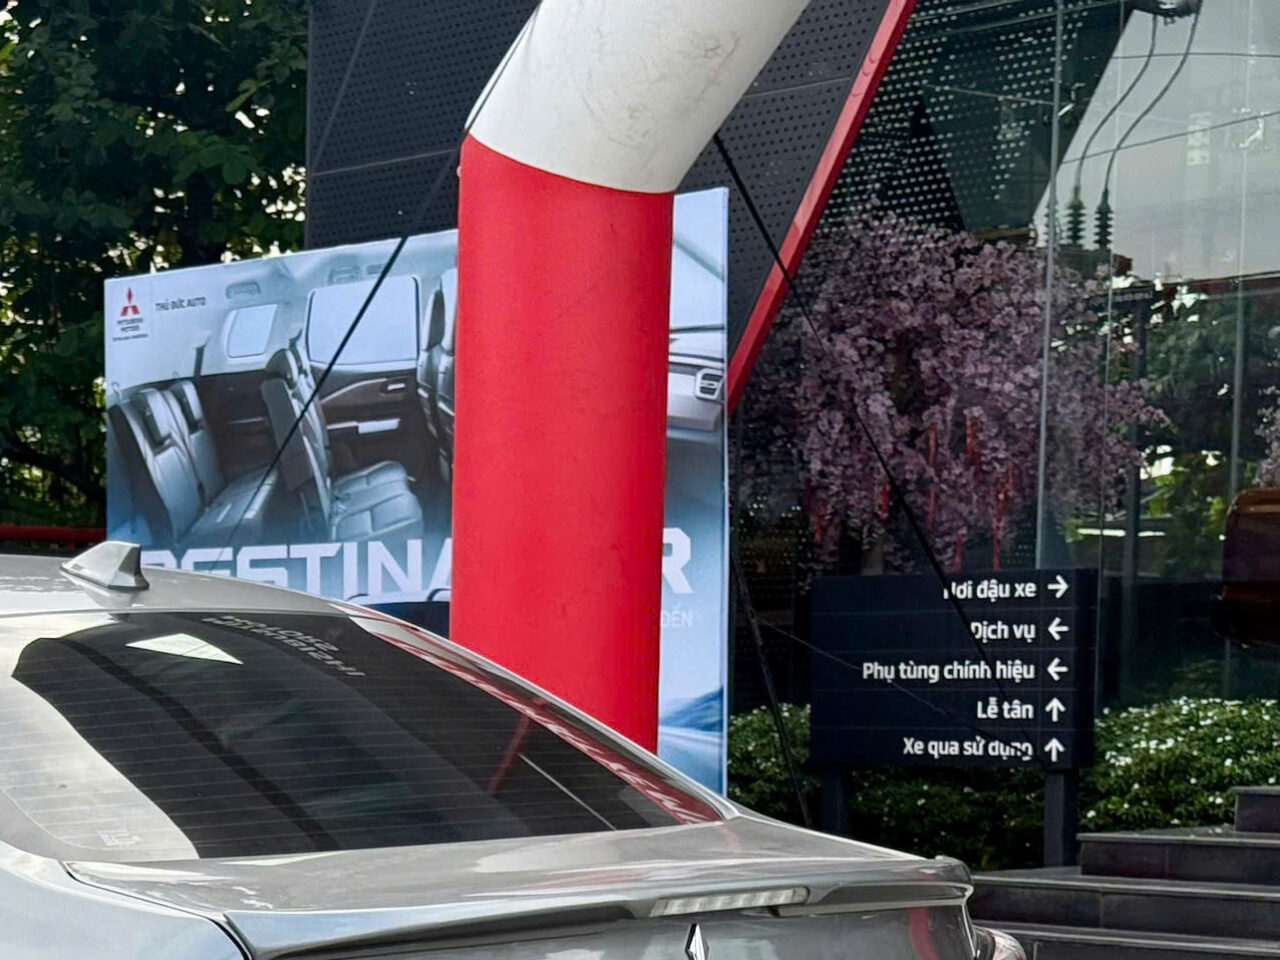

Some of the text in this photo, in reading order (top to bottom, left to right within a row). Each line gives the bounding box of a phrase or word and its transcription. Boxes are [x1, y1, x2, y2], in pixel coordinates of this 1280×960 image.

[976, 579, 1010, 602] đậu
[1014, 582, 1037, 597] xe
[1012, 623, 1036, 643] vụ
[862, 659, 1035, 684] Phụ tùng chính hiệu
[977, 696, 1034, 719] Lễ tân
[903, 737, 925, 755] Xe
[928, 740, 960, 759] qua
[963, 735, 986, 756] sử
